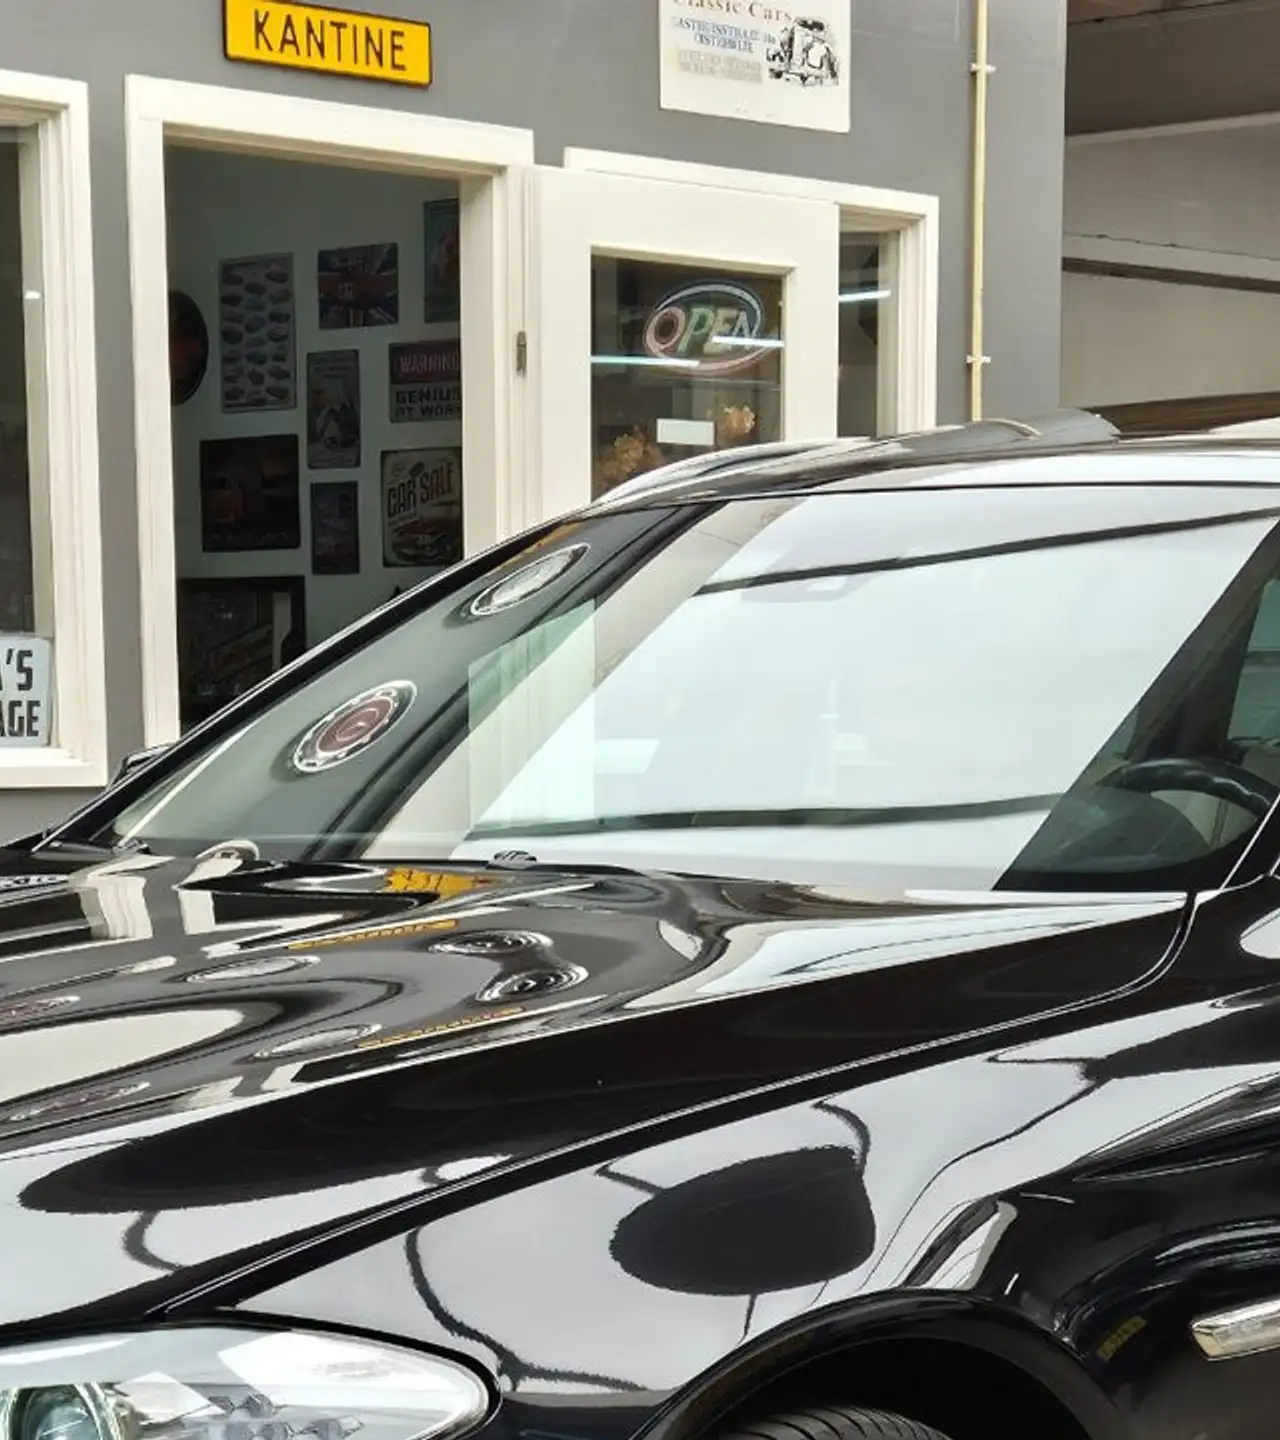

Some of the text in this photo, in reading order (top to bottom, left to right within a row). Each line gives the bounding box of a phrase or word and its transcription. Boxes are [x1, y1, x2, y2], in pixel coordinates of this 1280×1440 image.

[748, 2, 793, 22] Cars
[254, 9, 406, 71] KANTINE
[646, 306, 757, 354] OPEN
[388, 479, 416, 517] CAR
